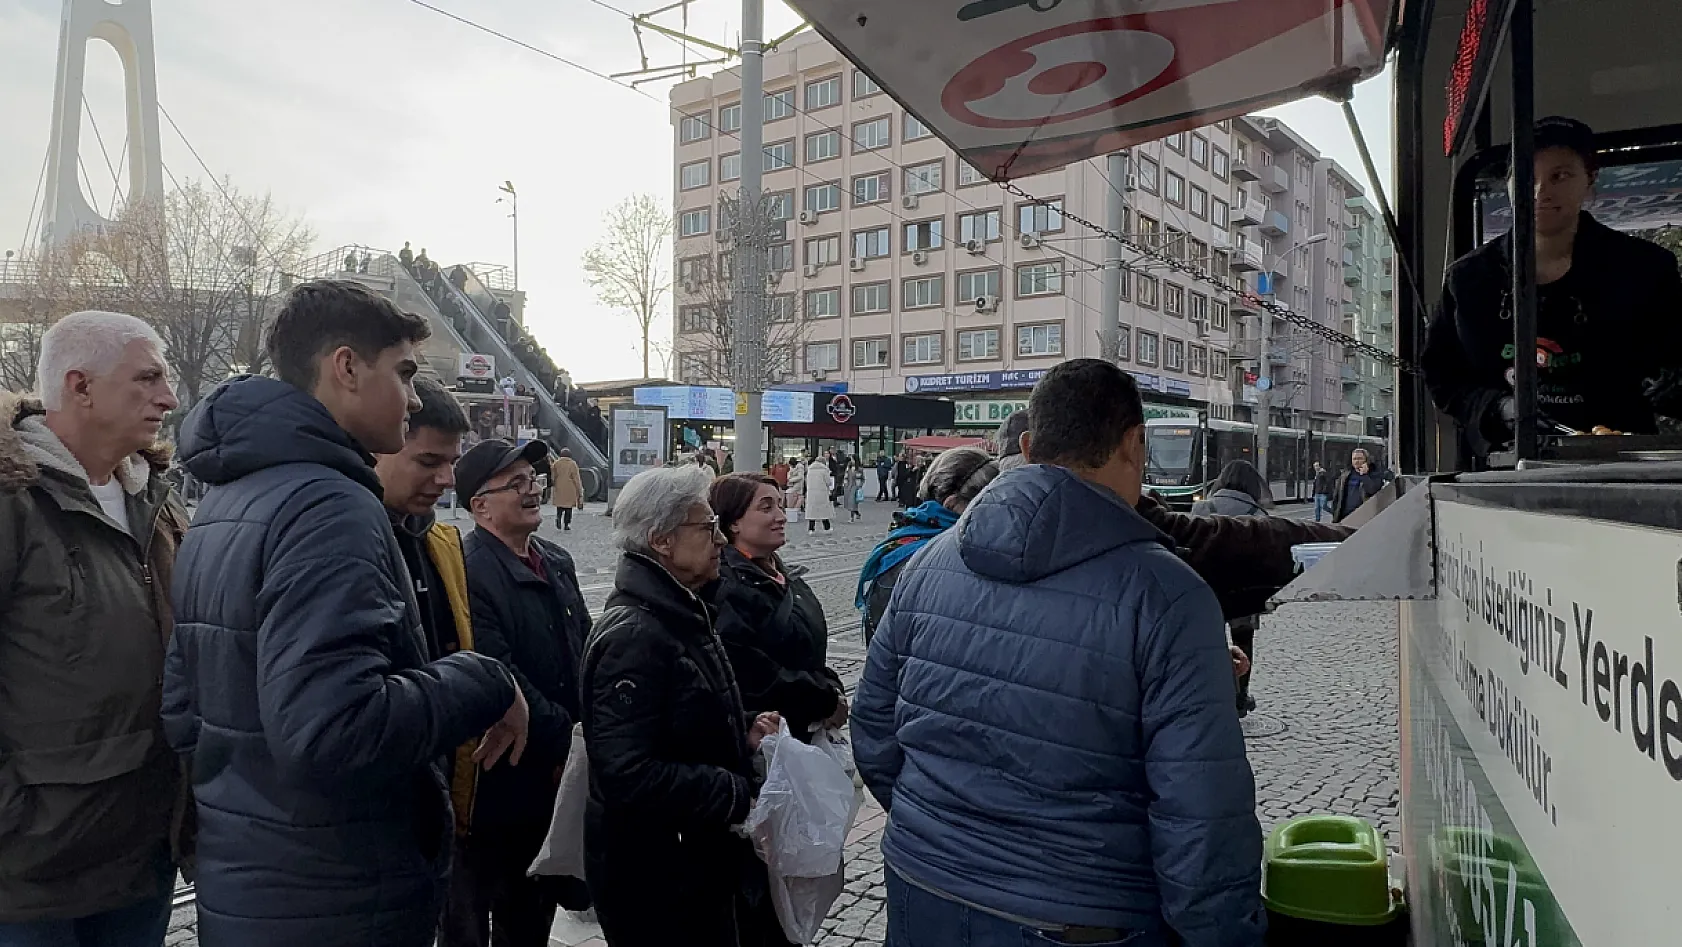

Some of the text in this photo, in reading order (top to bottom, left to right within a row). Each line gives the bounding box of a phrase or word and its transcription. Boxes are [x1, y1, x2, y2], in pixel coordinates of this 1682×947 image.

[920, 376, 953, 386] KUDRET
[1480, 540, 1567, 690] İstediğiniz
[1572, 601, 1682, 781] Yerde
[1487, 667, 1557, 827] Dökülür.
